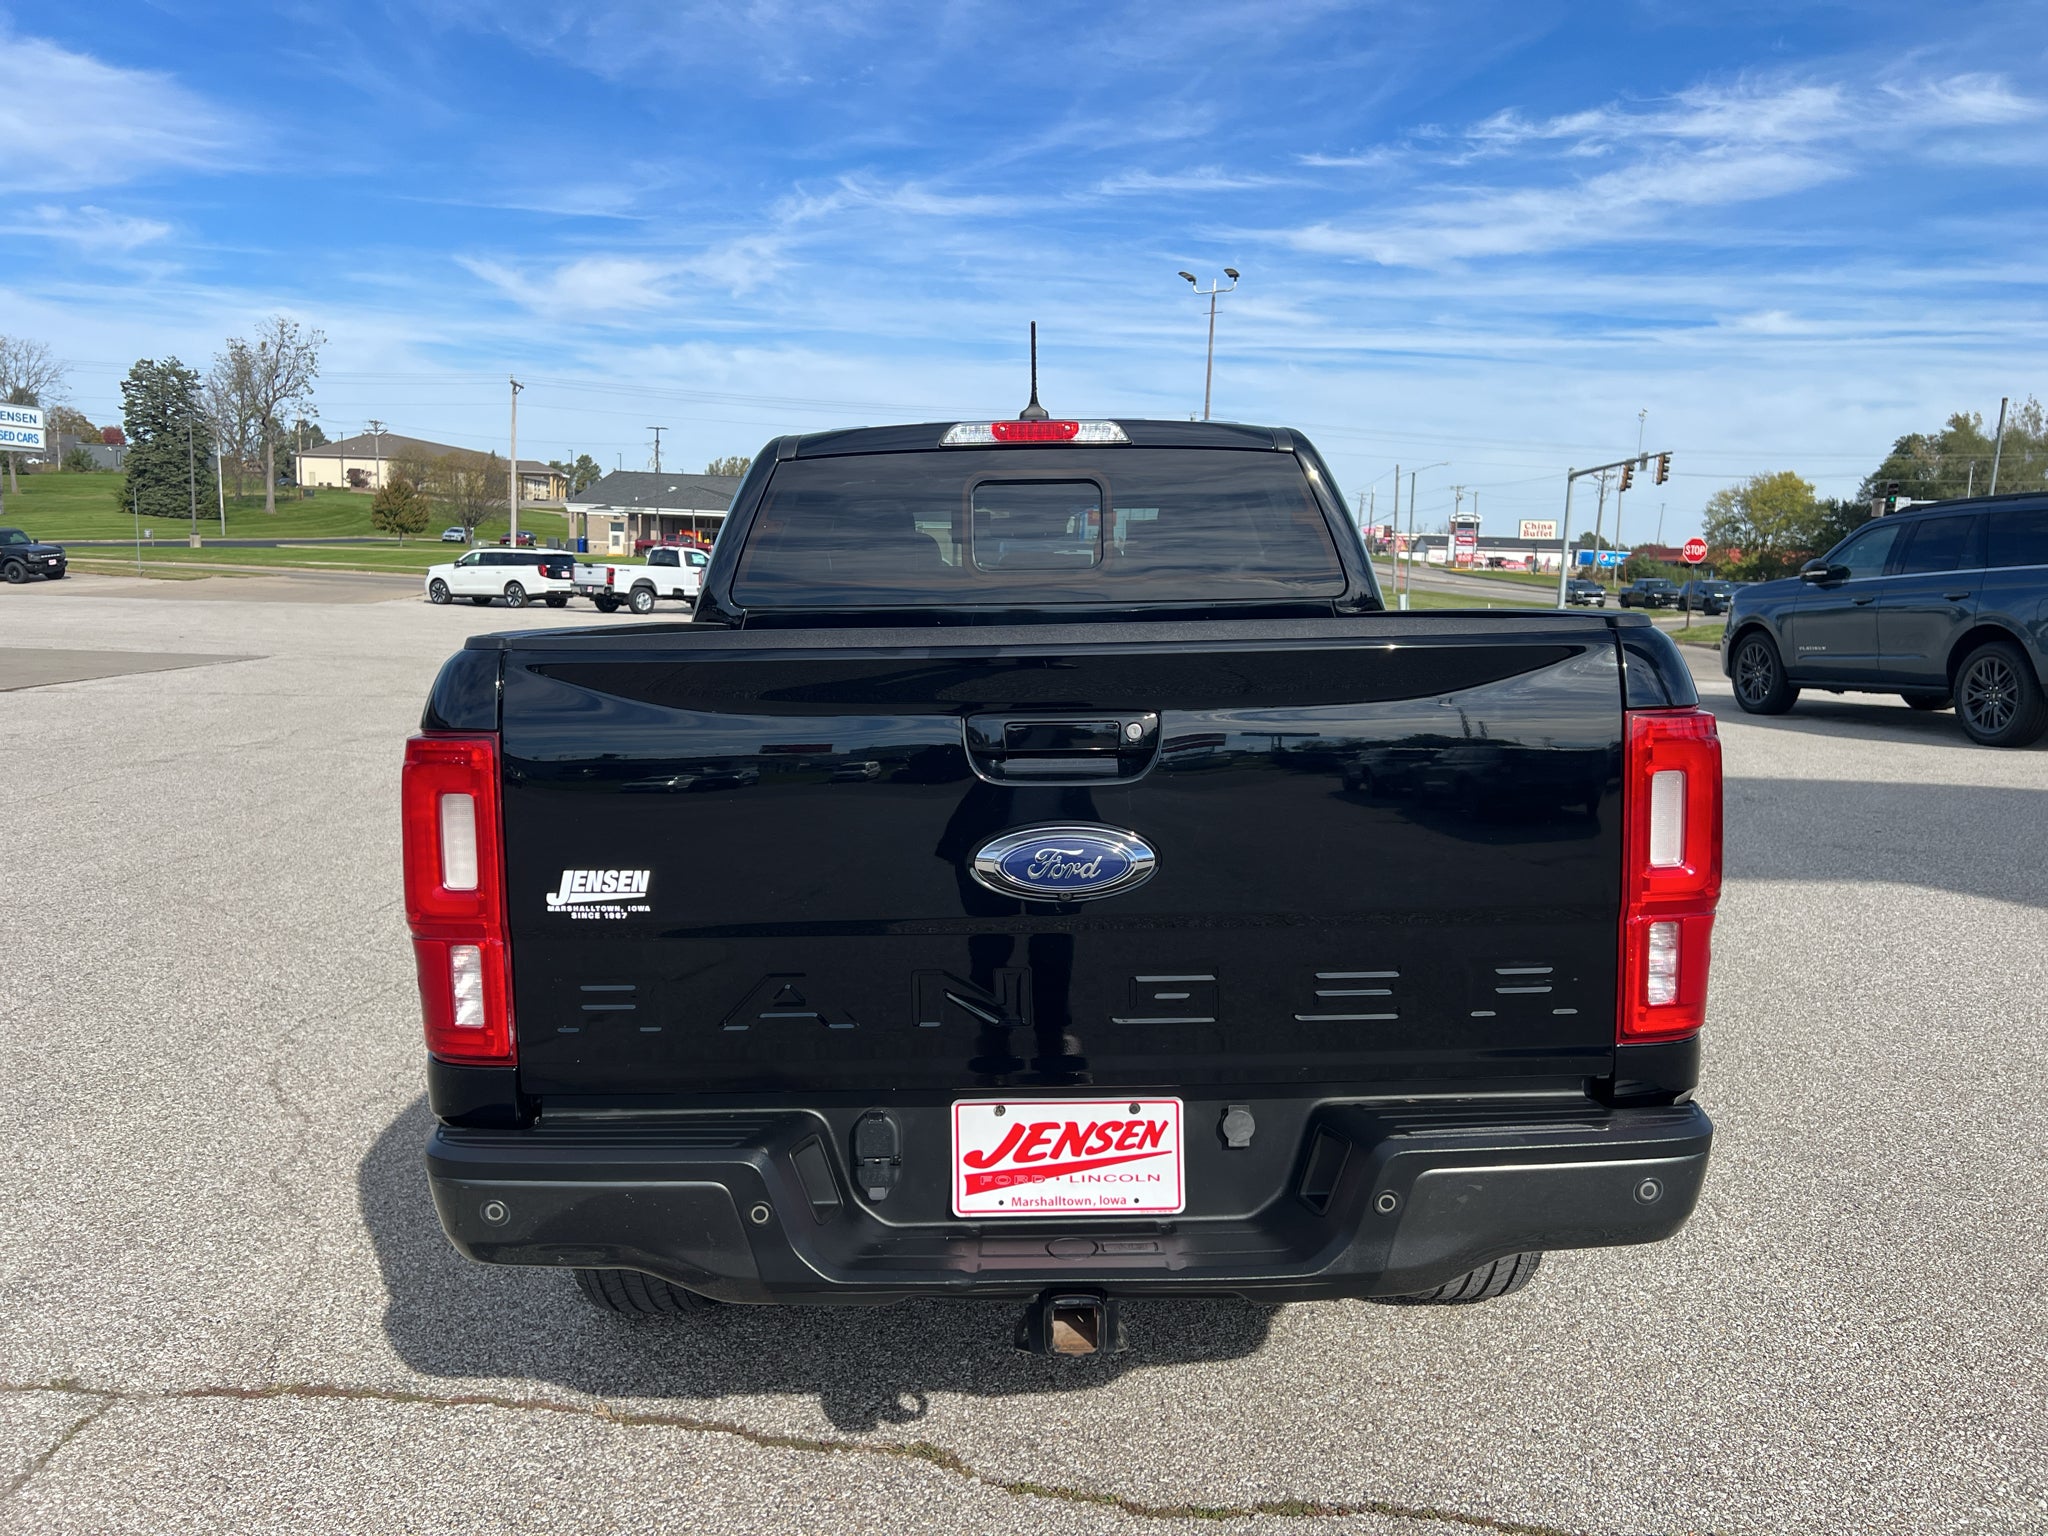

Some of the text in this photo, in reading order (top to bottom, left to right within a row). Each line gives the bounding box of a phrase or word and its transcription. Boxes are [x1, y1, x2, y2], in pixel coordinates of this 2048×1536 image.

[17, 432, 39, 444] CARS
[1524, 522, 1553, 530] China
[1685, 545, 1705, 555] STOP
[1027, 848, 1103, 880] Ford
[546, 869, 651, 905] JENSEN
[963, 1120, 1169, 1169] JENSEN
[980, 1174, 1160, 1185] FORD LINCOLN
[1011, 1195, 1127, 1207] Marshalltown, Iowa
